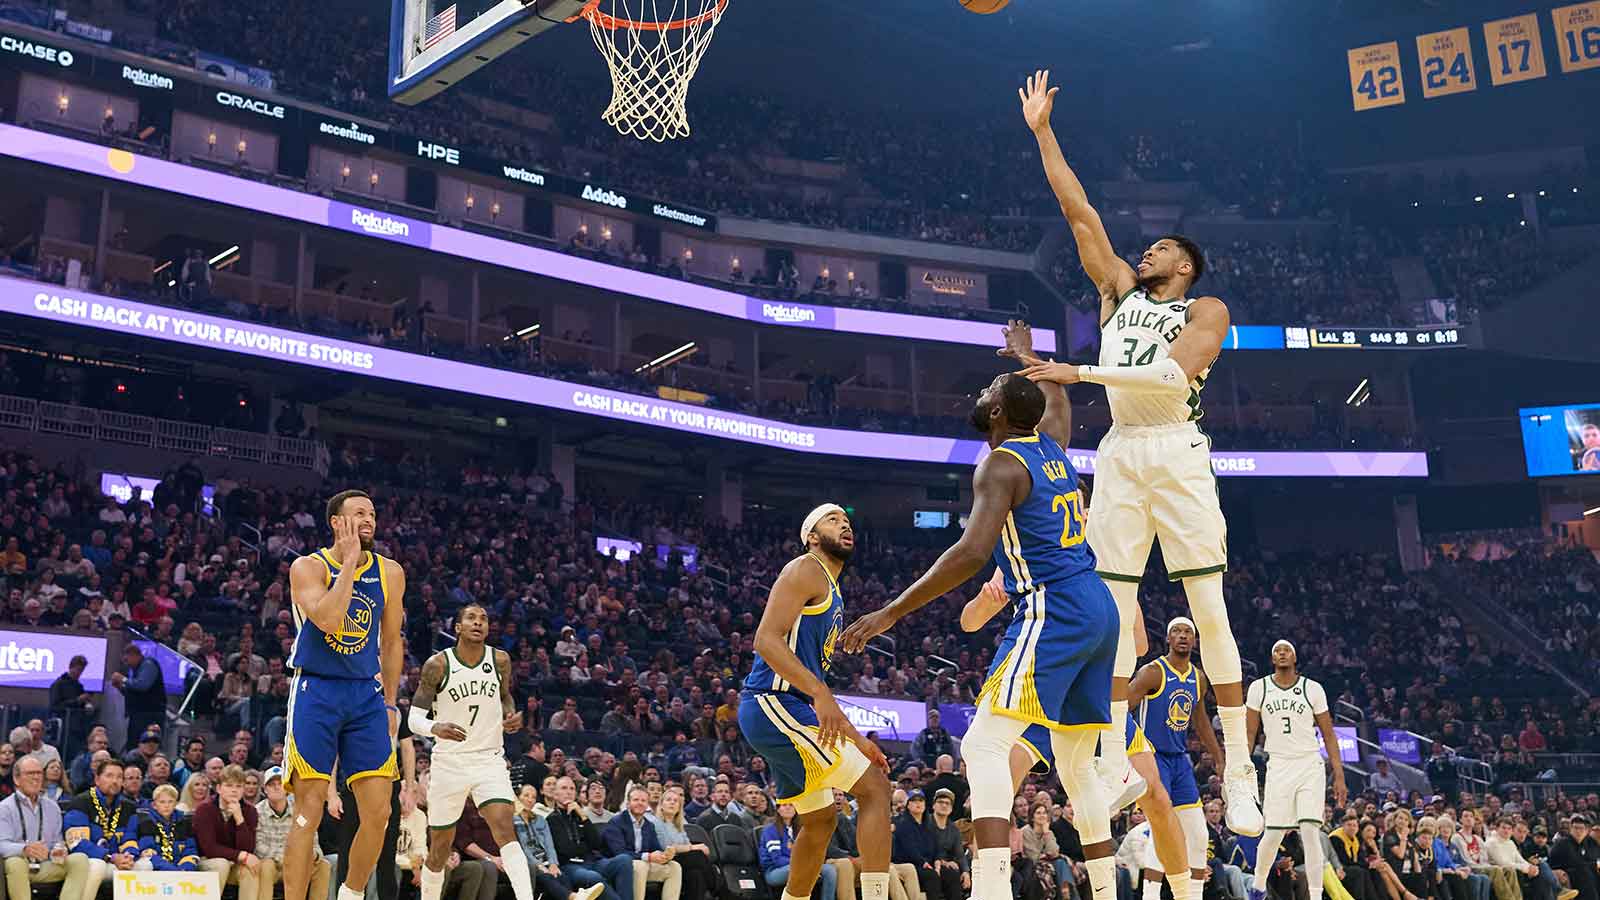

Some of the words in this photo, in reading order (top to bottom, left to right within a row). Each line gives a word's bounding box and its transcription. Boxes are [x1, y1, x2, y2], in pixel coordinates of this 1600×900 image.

[0, 36, 57, 62] CHASE
[1565, 27, 1600, 63] 16
[1424, 52, 1471, 89] 24
[1497, 40, 1531, 76] 17
[122, 65, 174, 90] Rakuten
[1357, 66, 1399, 100] 42
[216, 91, 286, 119] ORACLE
[319, 121, 375, 145] accenture
[418, 140, 460, 165] HPE
[503, 165, 545, 186] verizon
[581, 184, 627, 209] Adobe
[351, 208, 409, 236] Rakuten
[653, 204, 707, 227] ticketmaster
[762, 303, 815, 322] Rakuten
[34, 293, 87, 319] CASH
[91, 302, 144, 329] BACK
[144, 313, 170, 333] AT
[172, 318, 222, 342] YOUR
[224, 327, 308, 357] FAVORITE
[309, 344, 374, 369] STORES
[1116, 310, 1183, 344] BUCKS
[1318, 332, 1339, 343] LAL
[1370, 332, 1392, 343] SAS
[1117, 337, 1158, 367] 34
[572, 391, 611, 411] CASH
[613, 398, 649, 419] BACK
[650, 407, 668, 421] AT
[669, 409, 706, 429] YOUR
[706, 415, 766, 440] FAVORITE
[767, 429, 816, 448] STORES
[1071, 455, 1088, 469] AT
[1210, 457, 1256, 471] TORES
[1051, 491, 1086, 549] 23
[353, 608, 370, 625] 30
[448, 680, 497, 703] BUCKS
[468, 704, 479, 727] 7
[1265, 699, 1306, 715] BUCKS
[1281, 716, 1292, 734] 3
